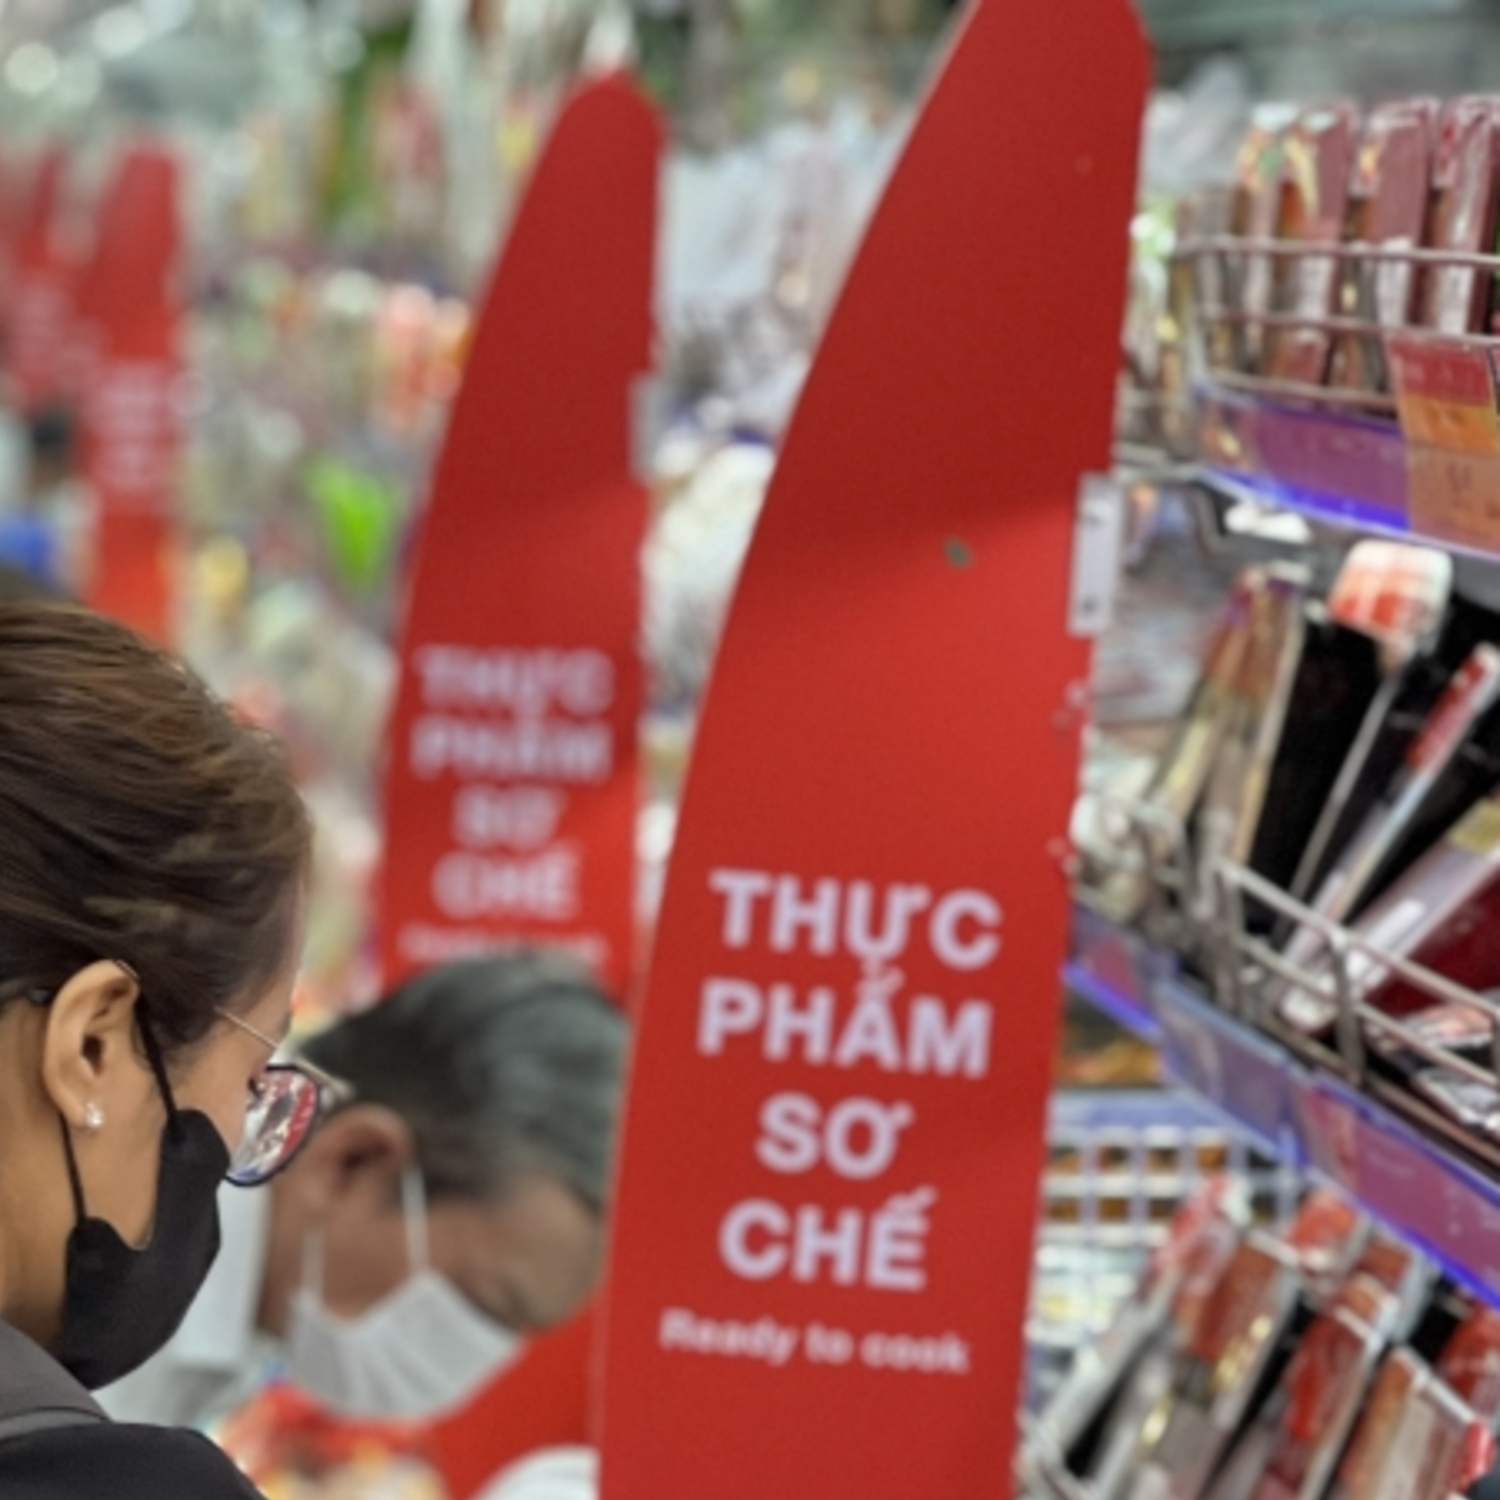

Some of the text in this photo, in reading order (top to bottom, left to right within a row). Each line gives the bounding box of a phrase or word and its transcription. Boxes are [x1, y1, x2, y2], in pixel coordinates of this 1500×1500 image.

[709, 867, 1002, 974] THỰC
[697, 964, 992, 1079] PHẨM
[755, 1091, 915, 1180] SƠ
[718, 1185, 938, 1292] CHẾ
[660, 1307, 970, 1375] Ready to cook
